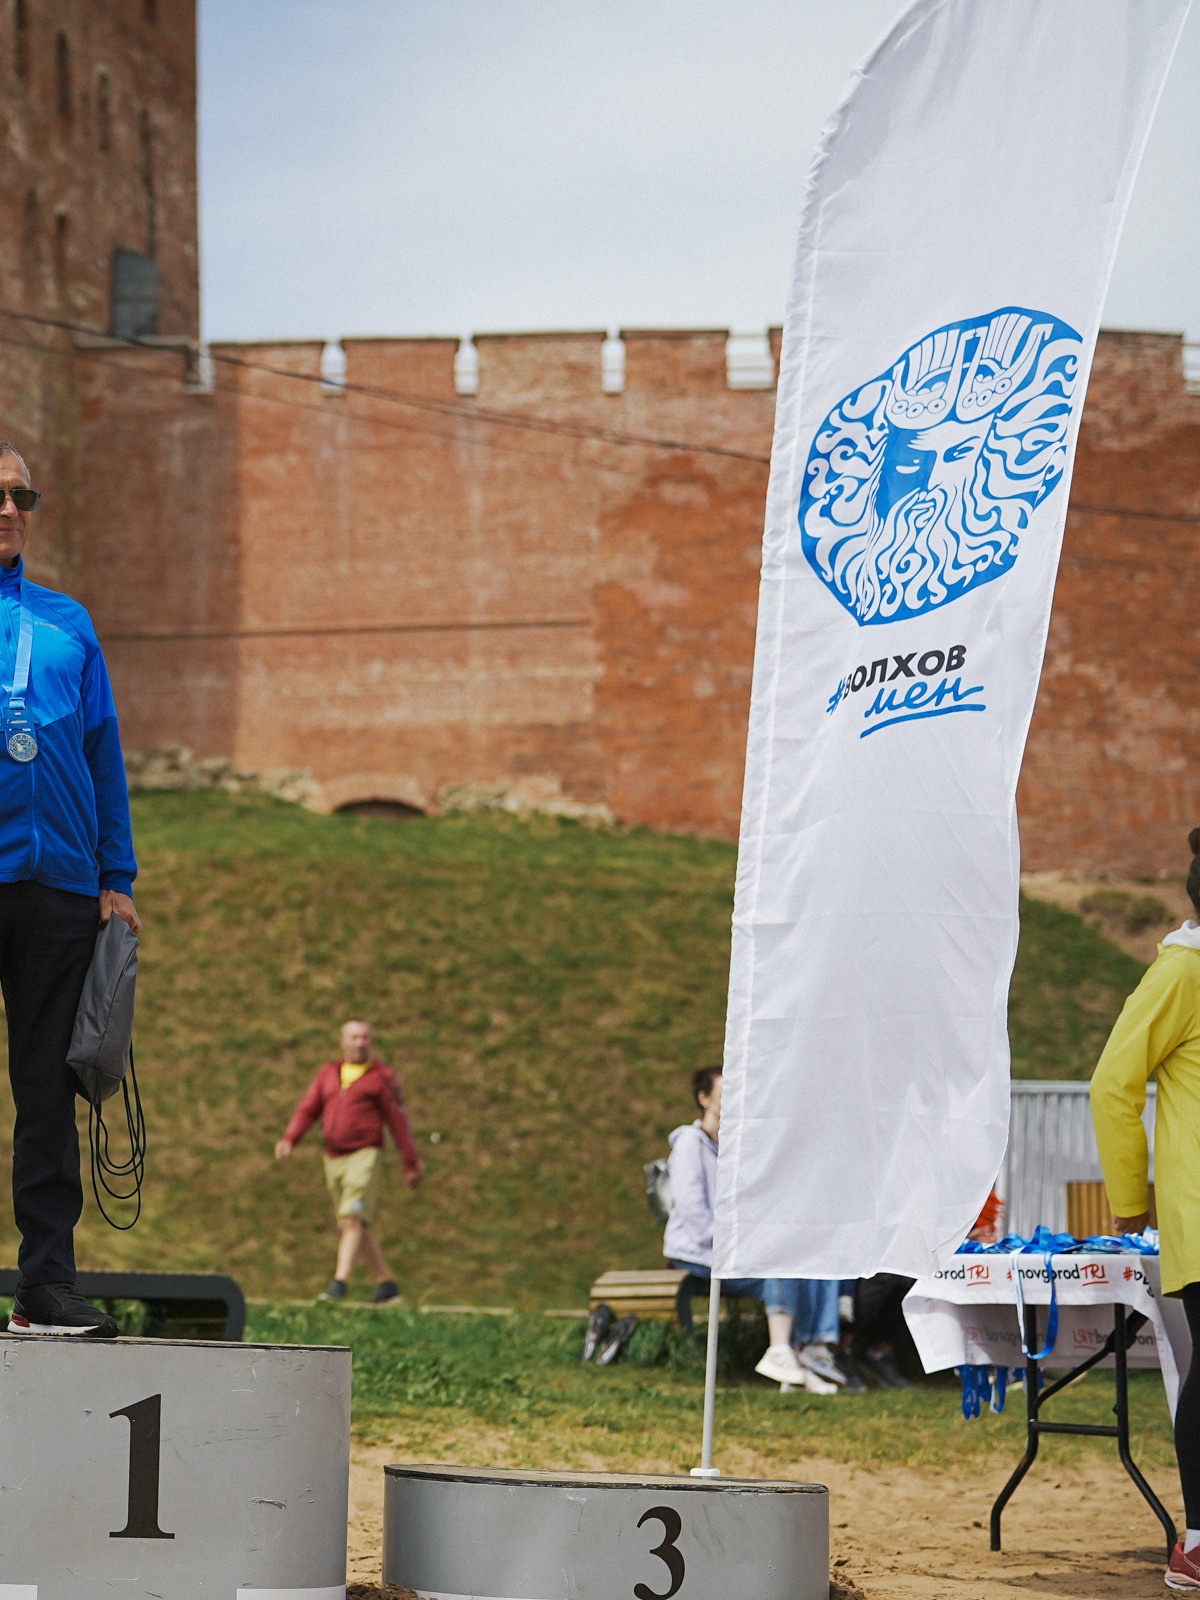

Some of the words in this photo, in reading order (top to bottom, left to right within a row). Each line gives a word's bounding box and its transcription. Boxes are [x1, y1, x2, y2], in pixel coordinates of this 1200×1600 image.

[863, 677, 985, 720] мен
[109, 1394, 175, 1539] 1
[633, 1506, 685, 1600] 3
